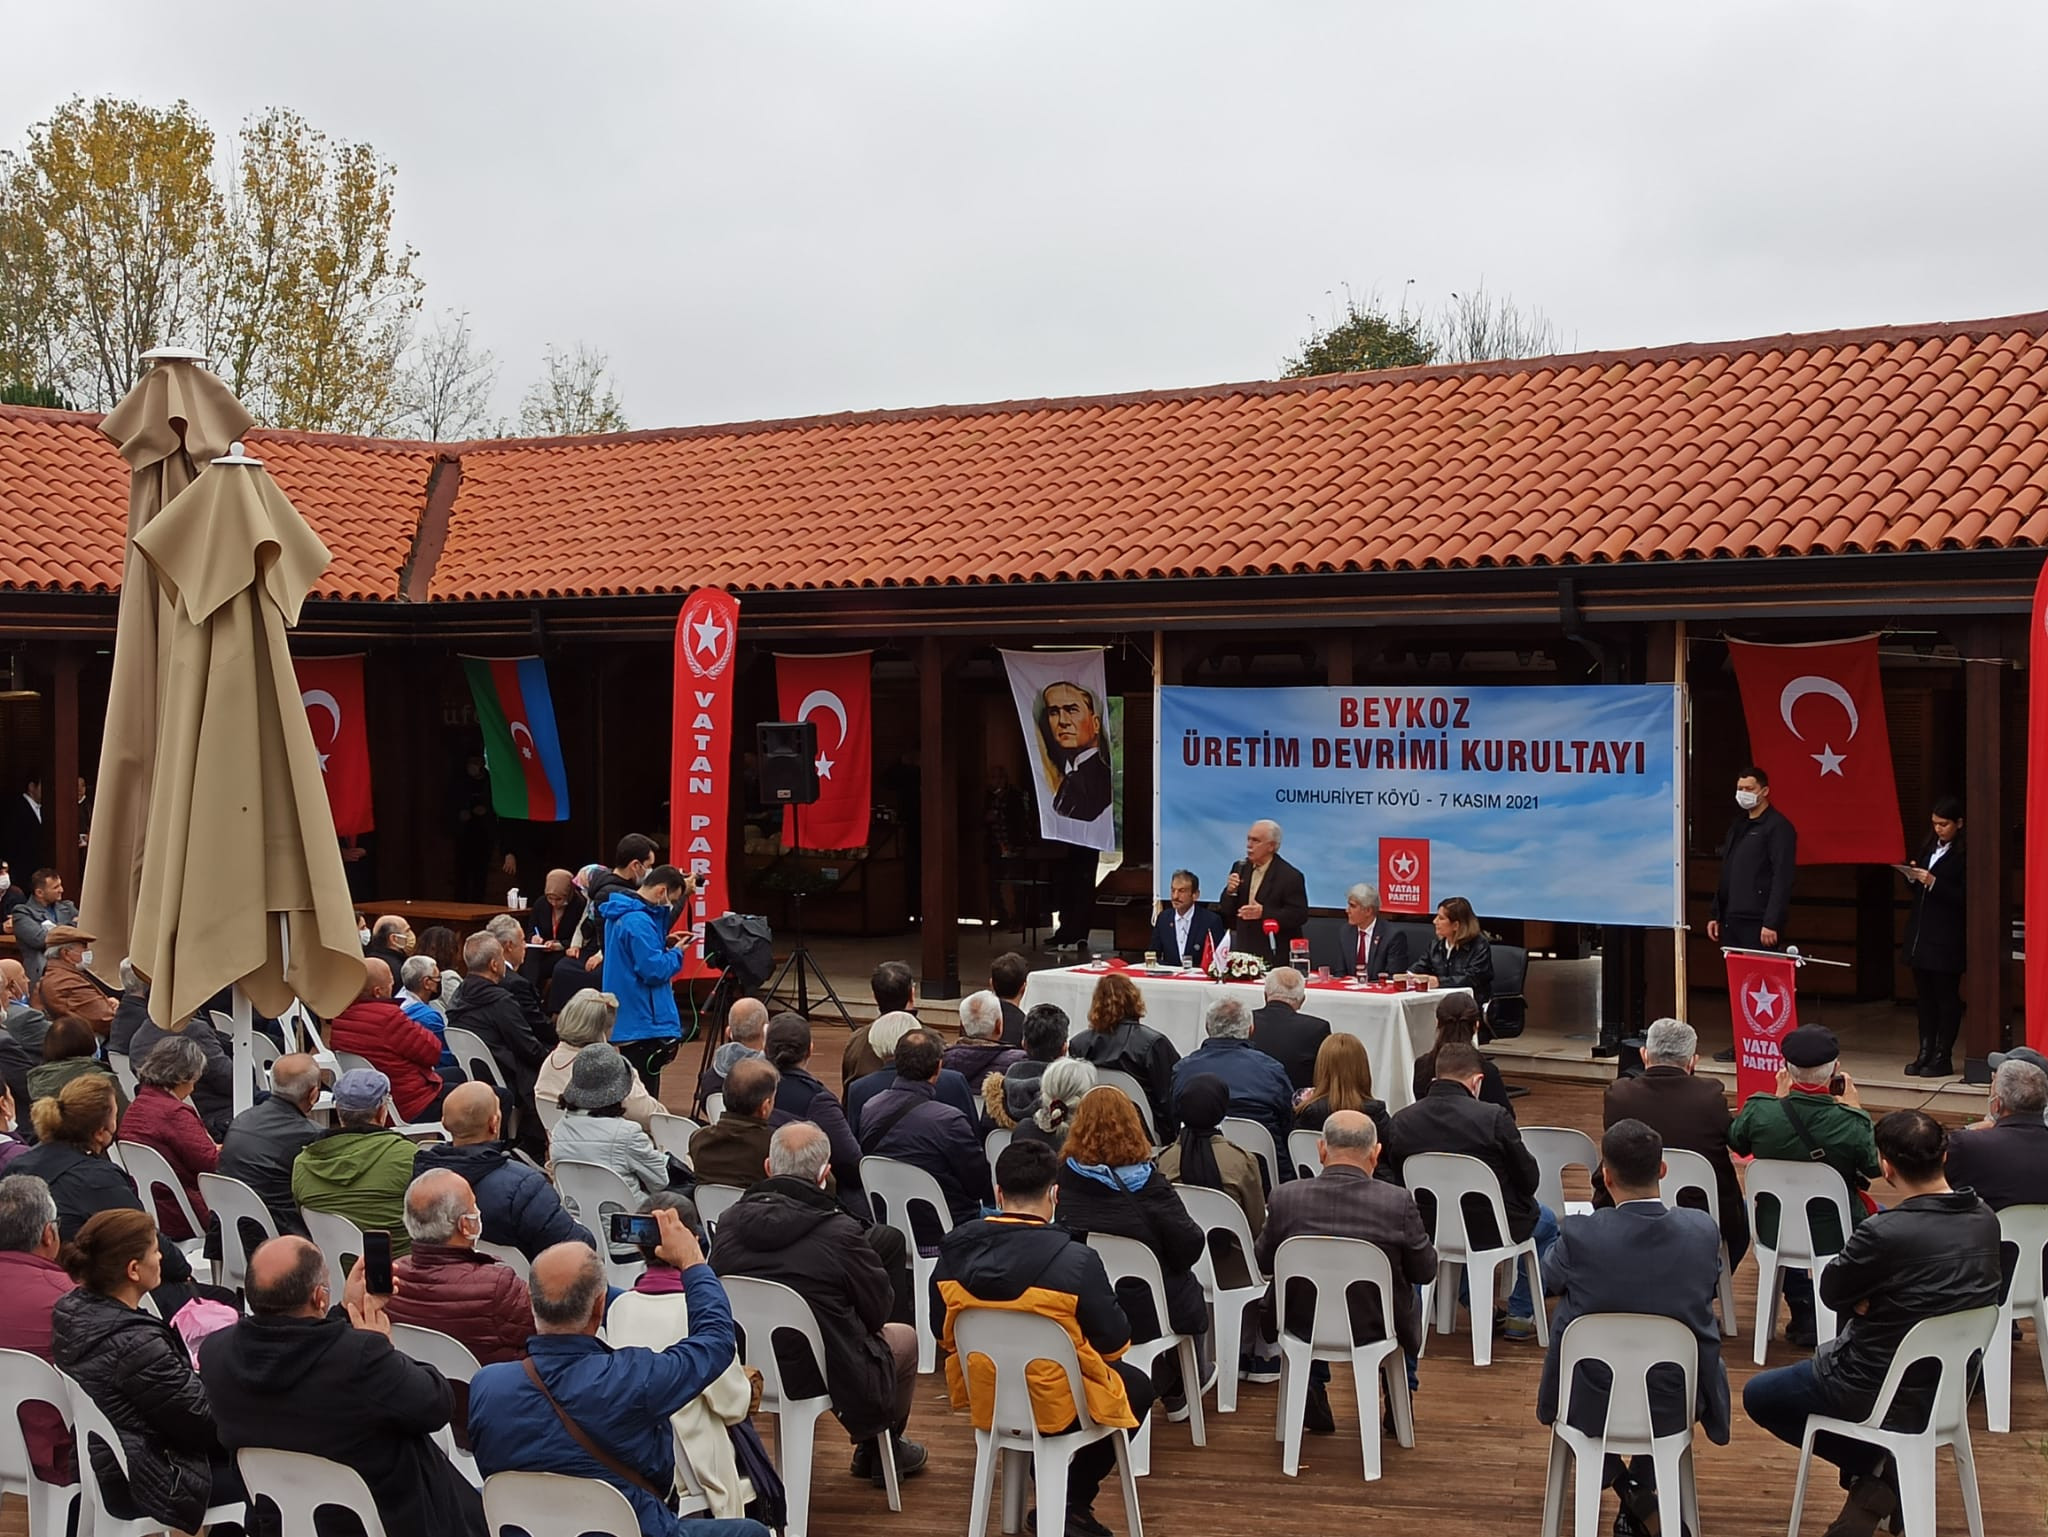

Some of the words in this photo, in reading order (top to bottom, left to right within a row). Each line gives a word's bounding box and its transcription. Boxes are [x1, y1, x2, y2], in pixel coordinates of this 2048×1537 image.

[1340, 697, 1470, 728] BEYKOZ
[689, 691, 715, 794] VATAN
[1182, 729, 1300, 768] ÜRETİM
[1312, 731, 1448, 770] DEVRİMİ
[1461, 740, 1645, 774] KURULTAYI
[1275, 787, 1373, 805] CUMHURİYET
[1377, 788, 1420, 806] KÖYÜ
[1439, 793, 1448, 807] 7
[1453, 793, 1501, 808] KASIM
[1506, 795, 1539, 809] 2021
[1388, 884, 1420, 893] VATAN
[1742, 1037, 1782, 1057] VATA
